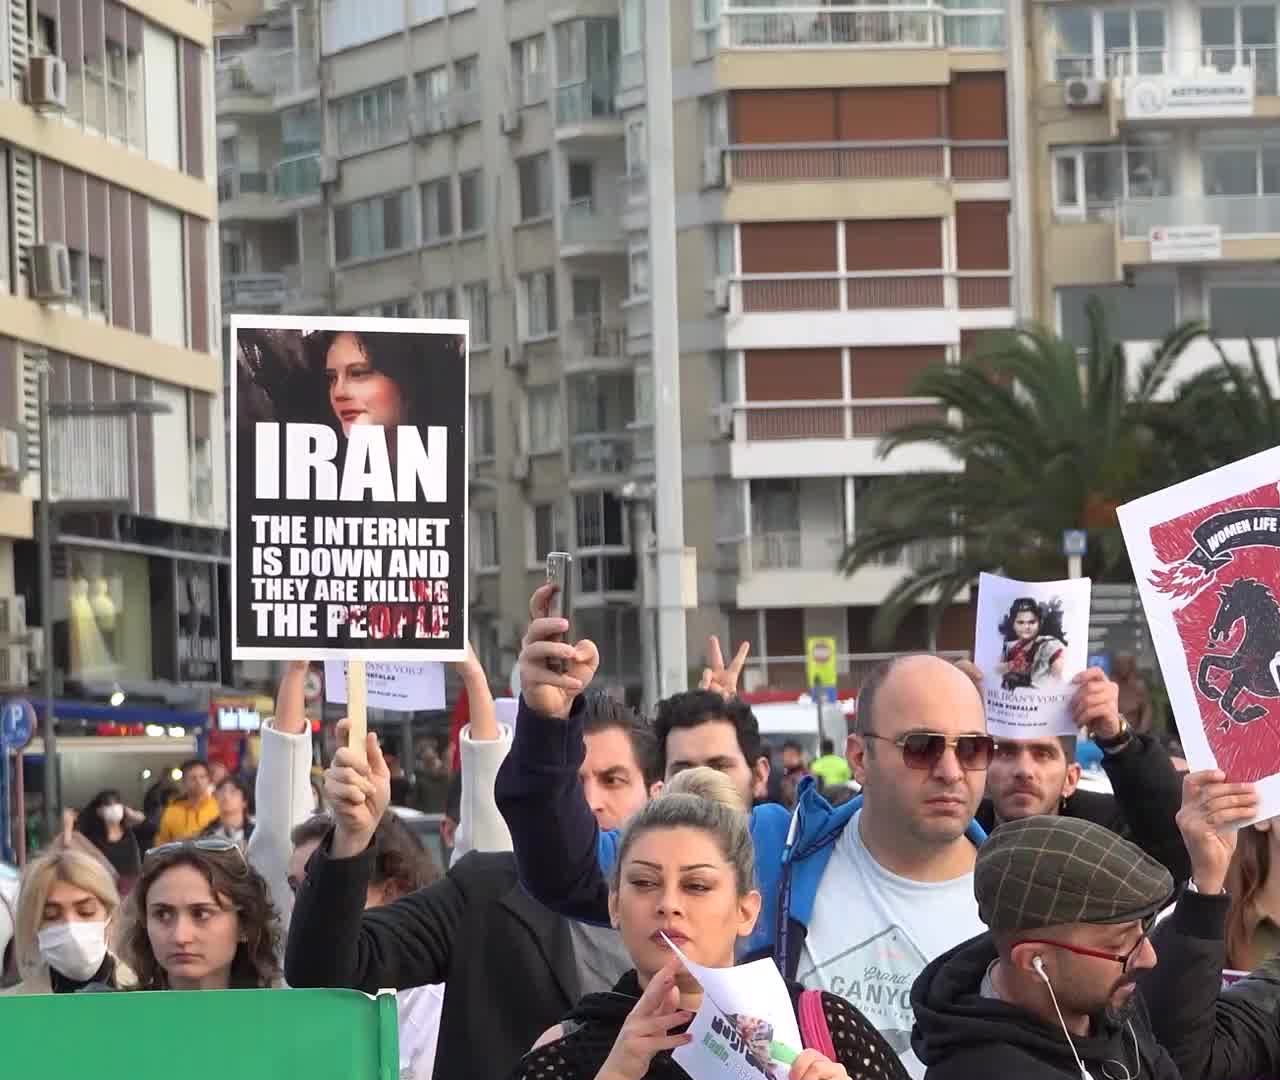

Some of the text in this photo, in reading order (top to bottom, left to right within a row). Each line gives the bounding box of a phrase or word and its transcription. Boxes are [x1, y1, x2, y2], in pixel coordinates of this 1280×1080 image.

[256, 422, 448, 503] IRAN
[251, 515, 450, 547] THE INTERNET
[1207, 519, 1251, 552] WOMEN
[1253, 517, 1277, 532] LIFE
[252, 546, 449, 578] IS DOWN AND
[251, 578, 449, 602] THEY ARE KILLING
[251, 602, 450, 639] THE PEOPLE
[12, 706, 23, 729] P
